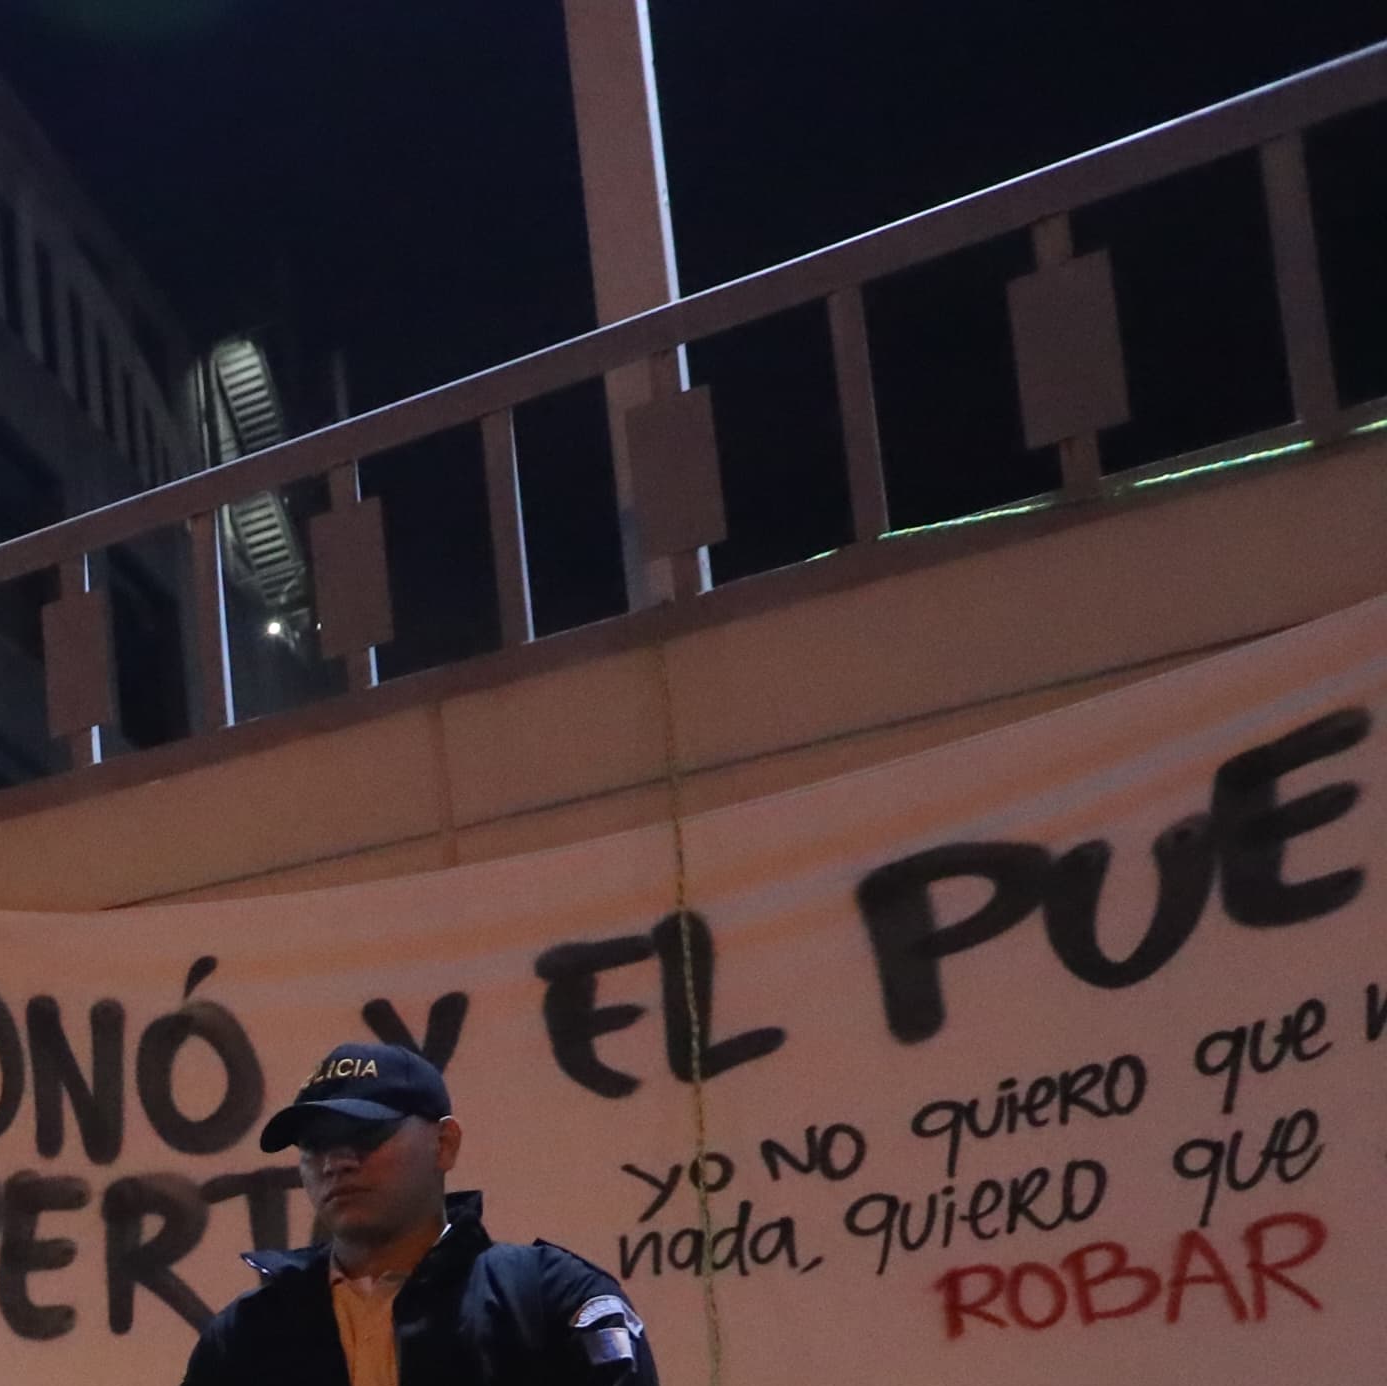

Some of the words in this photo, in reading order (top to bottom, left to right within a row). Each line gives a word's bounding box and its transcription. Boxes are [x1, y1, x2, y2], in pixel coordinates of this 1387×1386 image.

[534, 909, 786, 1099] EL
[856, 705, 1372, 1045] PUE
[1194, 997, 1334, 1114] que
[617, 1201, 824, 1280] nada,
[1172, 1107, 1326, 1228] que
[933, 1211, 1328, 1340] ROBAR
